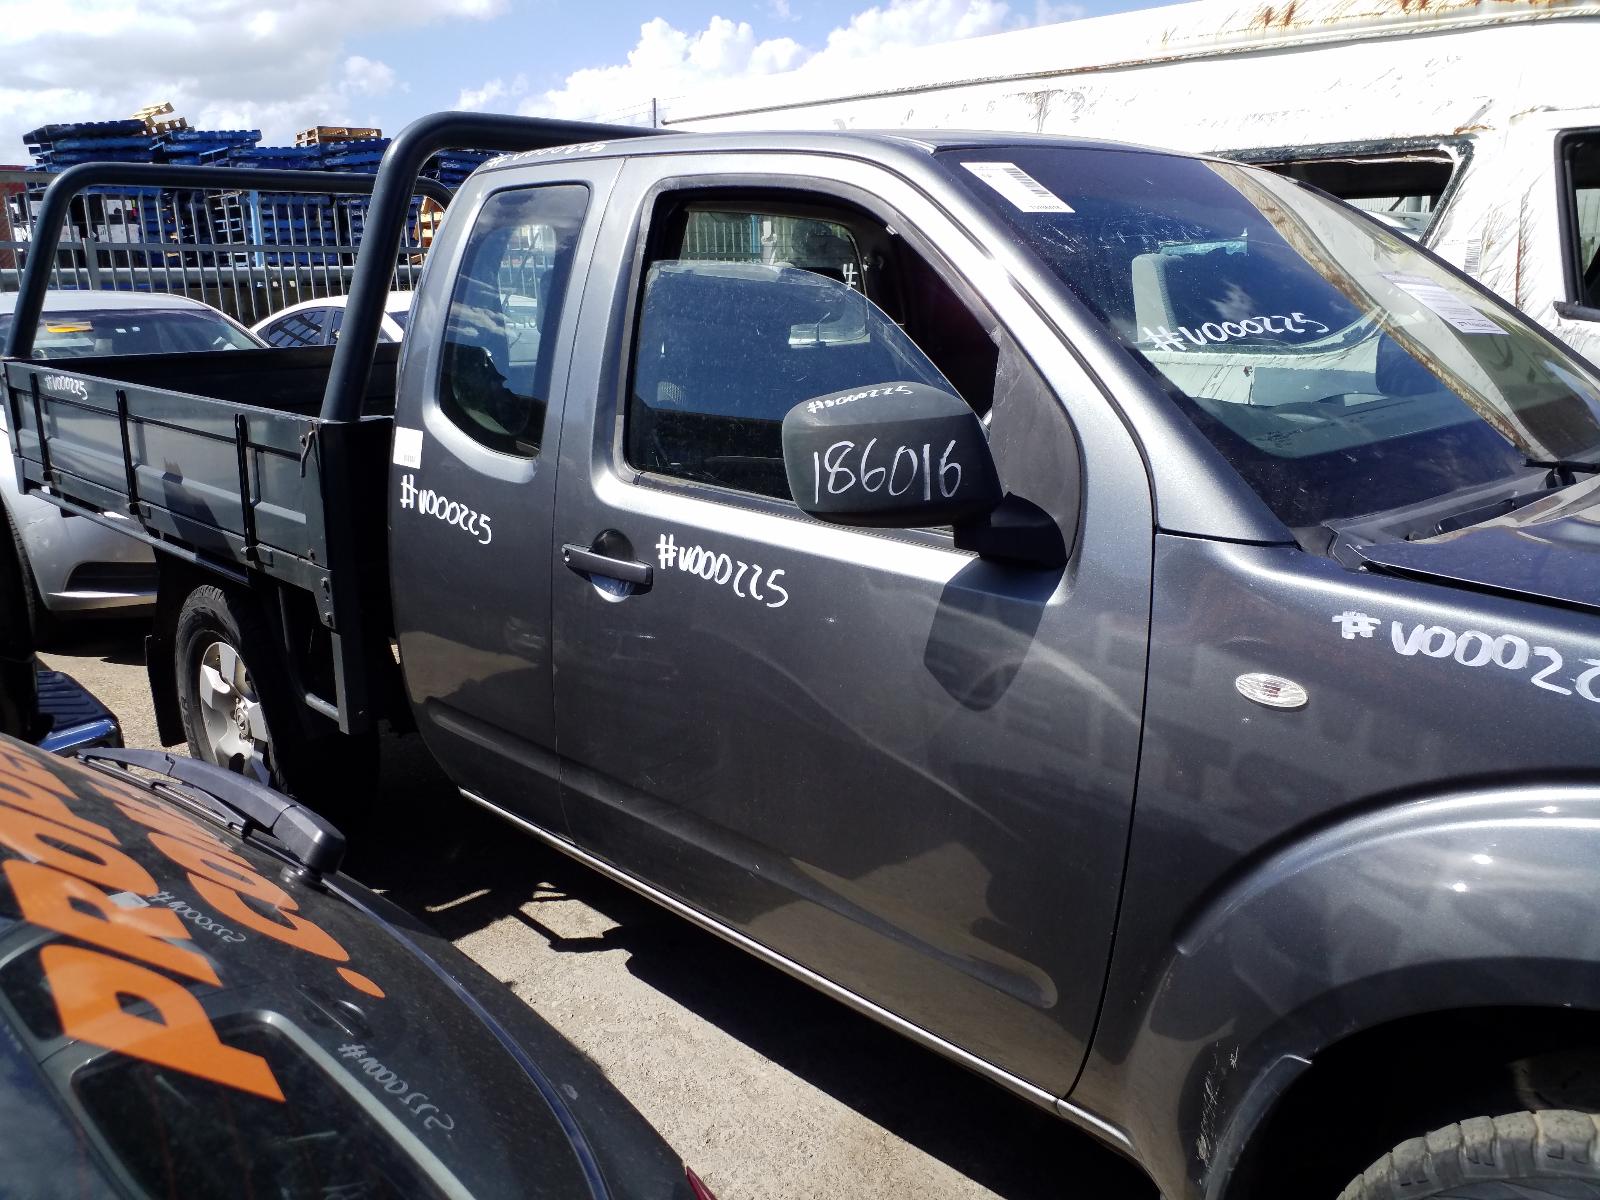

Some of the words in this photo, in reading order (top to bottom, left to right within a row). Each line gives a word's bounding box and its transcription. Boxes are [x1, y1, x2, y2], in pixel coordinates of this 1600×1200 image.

[1143, 312, 1330, 352] #V000225
[813, 437, 962, 504] 186016
[399, 473, 492, 545] #V000225
[655, 533, 789, 608] #V000225
